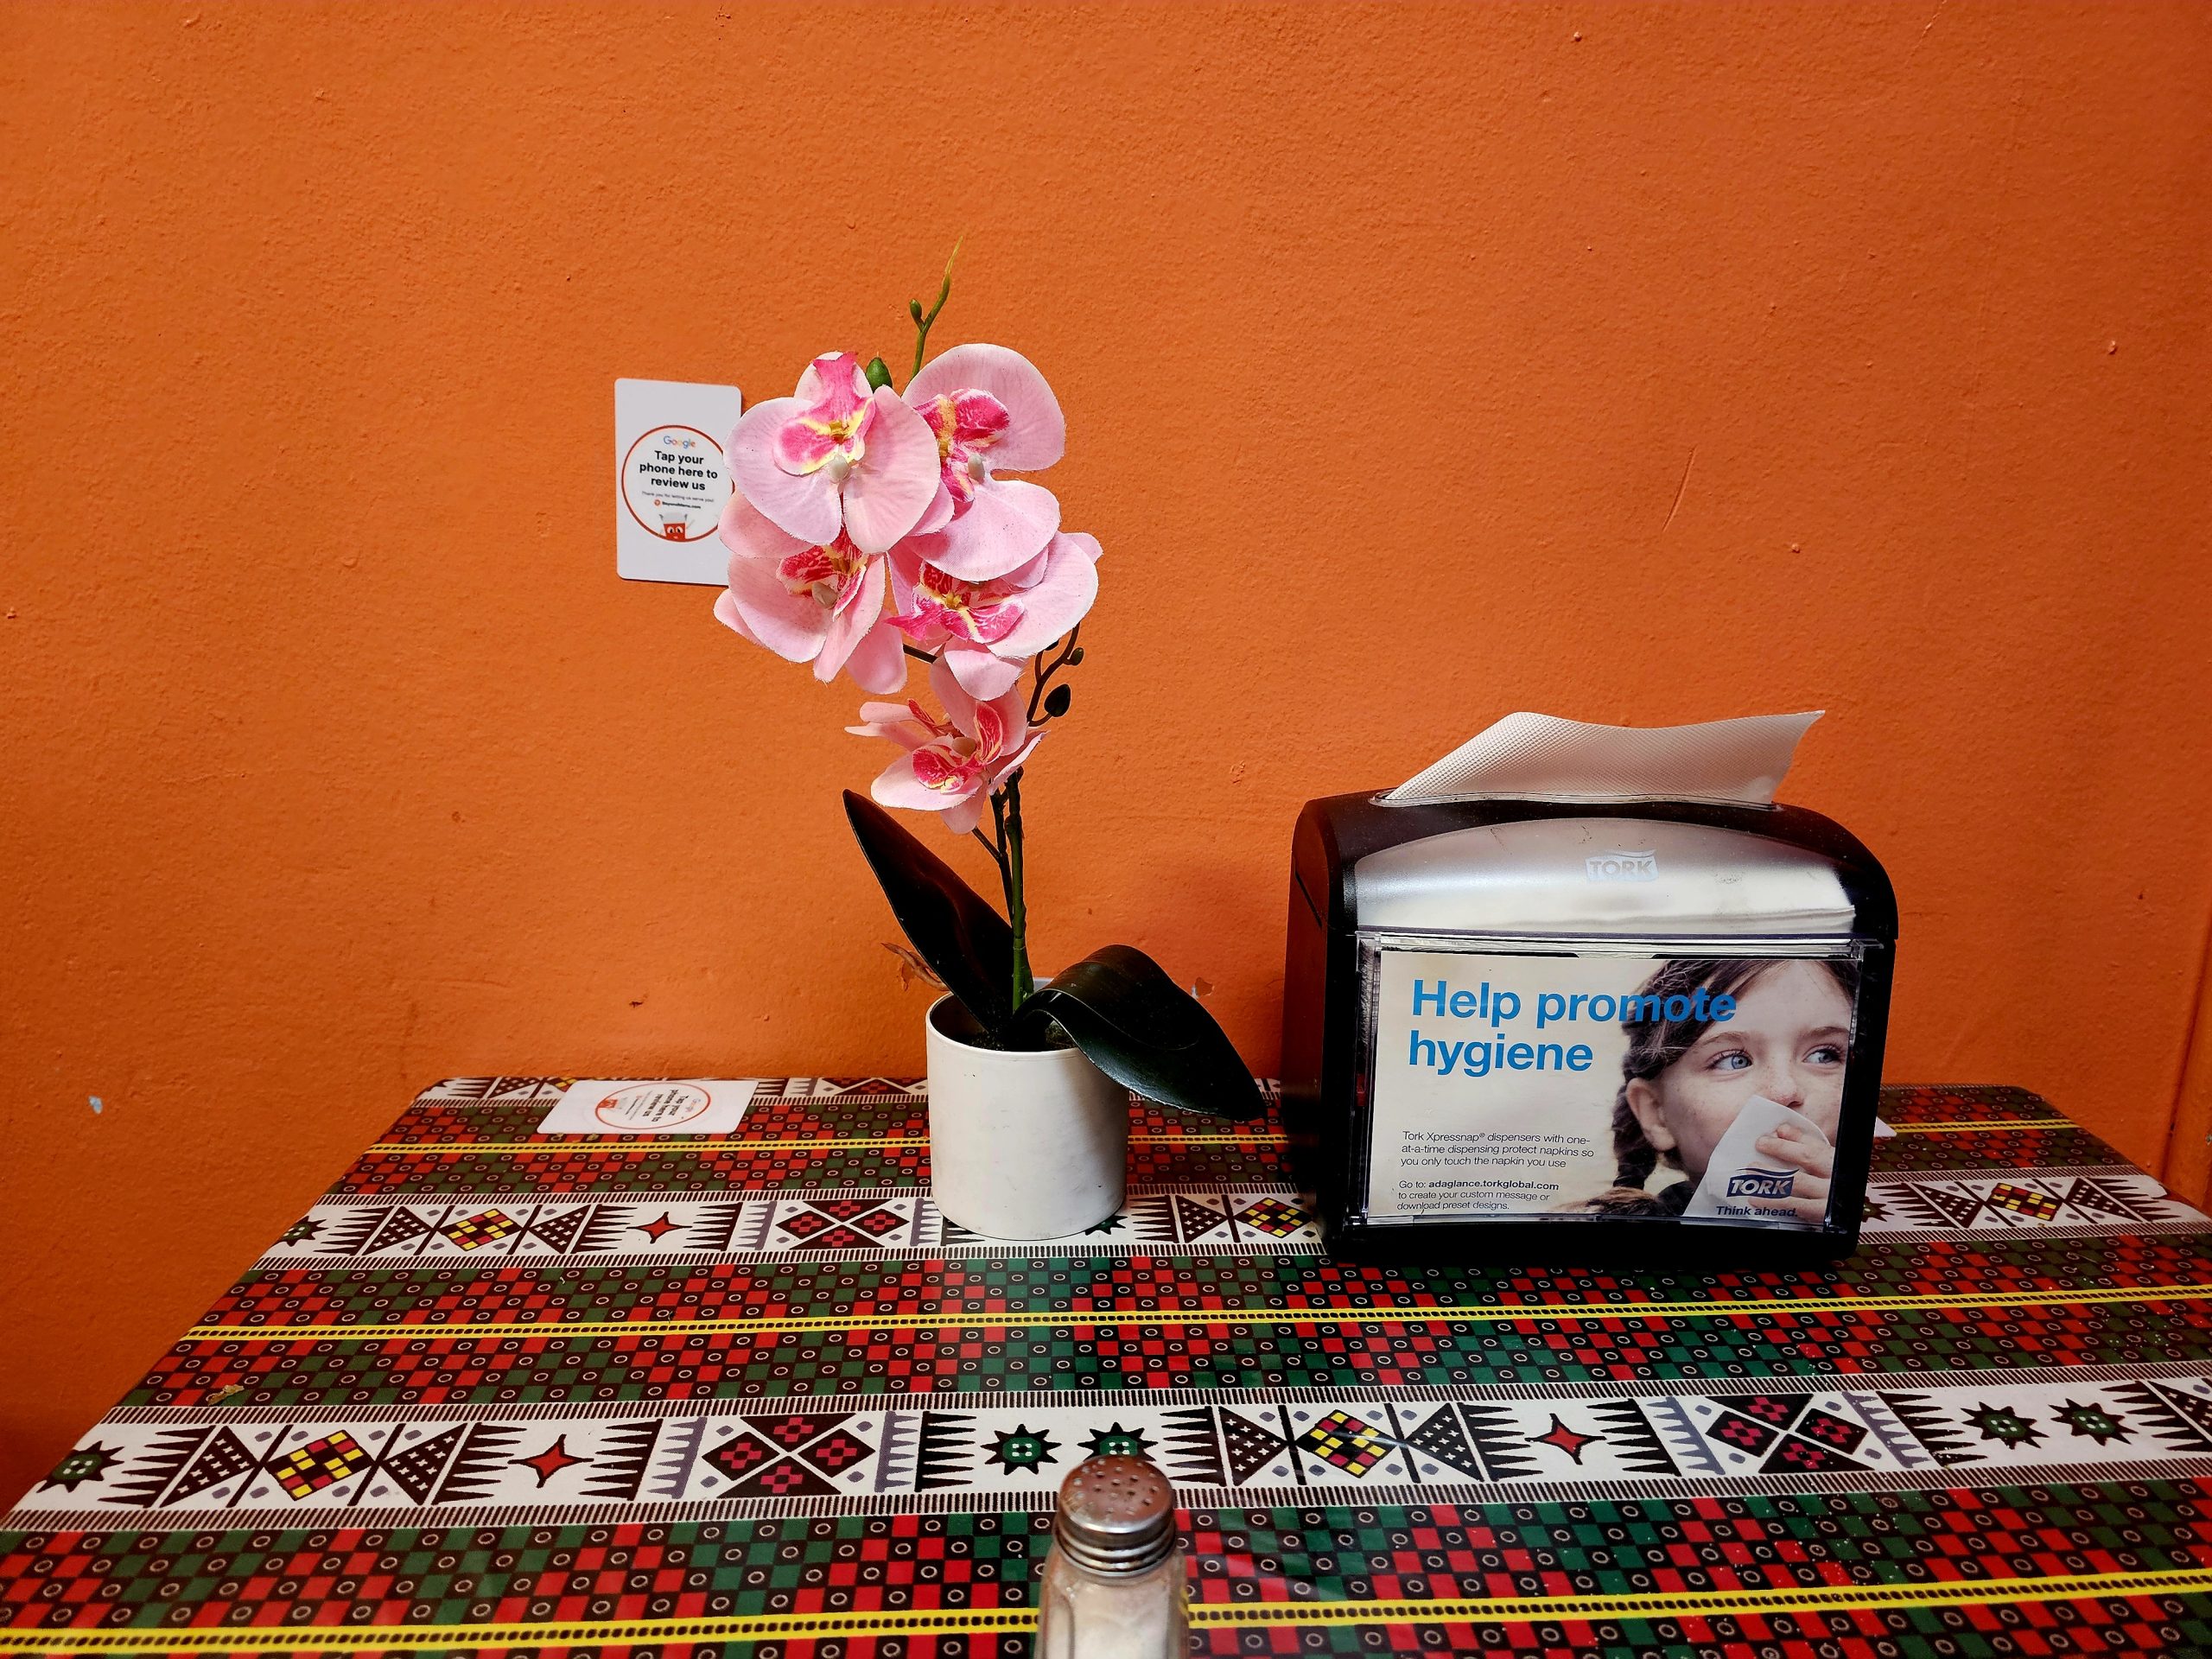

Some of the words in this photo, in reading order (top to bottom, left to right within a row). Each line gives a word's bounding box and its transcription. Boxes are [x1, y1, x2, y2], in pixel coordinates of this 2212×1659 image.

[664, 435, 696, 448] Google
[654, 450, 676, 463] Tap
[677, 455, 704, 465] your
[639, 463, 676, 474] phone
[678, 467, 703, 477] here
[707, 469, 718, 479] to
[651, 477, 689, 489] review
[692, 481, 706, 490] us
[1589, 860, 1652, 876] TORK
[1413, 979, 1522, 1028] Help
[1536, 987, 1737, 1029] promote
[1408, 1029, 1593, 1077] hygiene
[1402, 1130, 1424, 1141] Tork
[1487, 1133, 1541, 1143] dispensers
[1543, 1135, 1564, 1143] with
[1567, 1136, 1591, 1145] one-
[1402, 1145, 1445, 1154] at-a-time
[1447, 1145, 1499, 1155] dispensing
[1502, 1145, 1537, 1154] protect
[1540, 1147, 1579, 1157] napkins
[1401, 1158, 1419, 1166] you
[1421, 1157, 1442, 1167] only
[1444, 1156, 1471, 1166] touch
[1474, 1156, 1490, 1165] the
[1491, 1157, 1524, 1166] napkin
[1527, 1159, 1546, 1167] you
[1428, 1179, 1560, 1191] adaglance.torkglobal.com
[1731, 1179, 1792, 1195] TORK
[1438, 1192, 1459, 1200] your
[1496, 1192, 1537, 1202] message
[1396, 1201, 1441, 1210] download
[1442, 1201, 1471, 1210] preset
[1472, 1200, 1510, 1211] designs.
[1716, 1205, 1752, 1217] Think
[1754, 1207, 1798, 1217] ahead.
